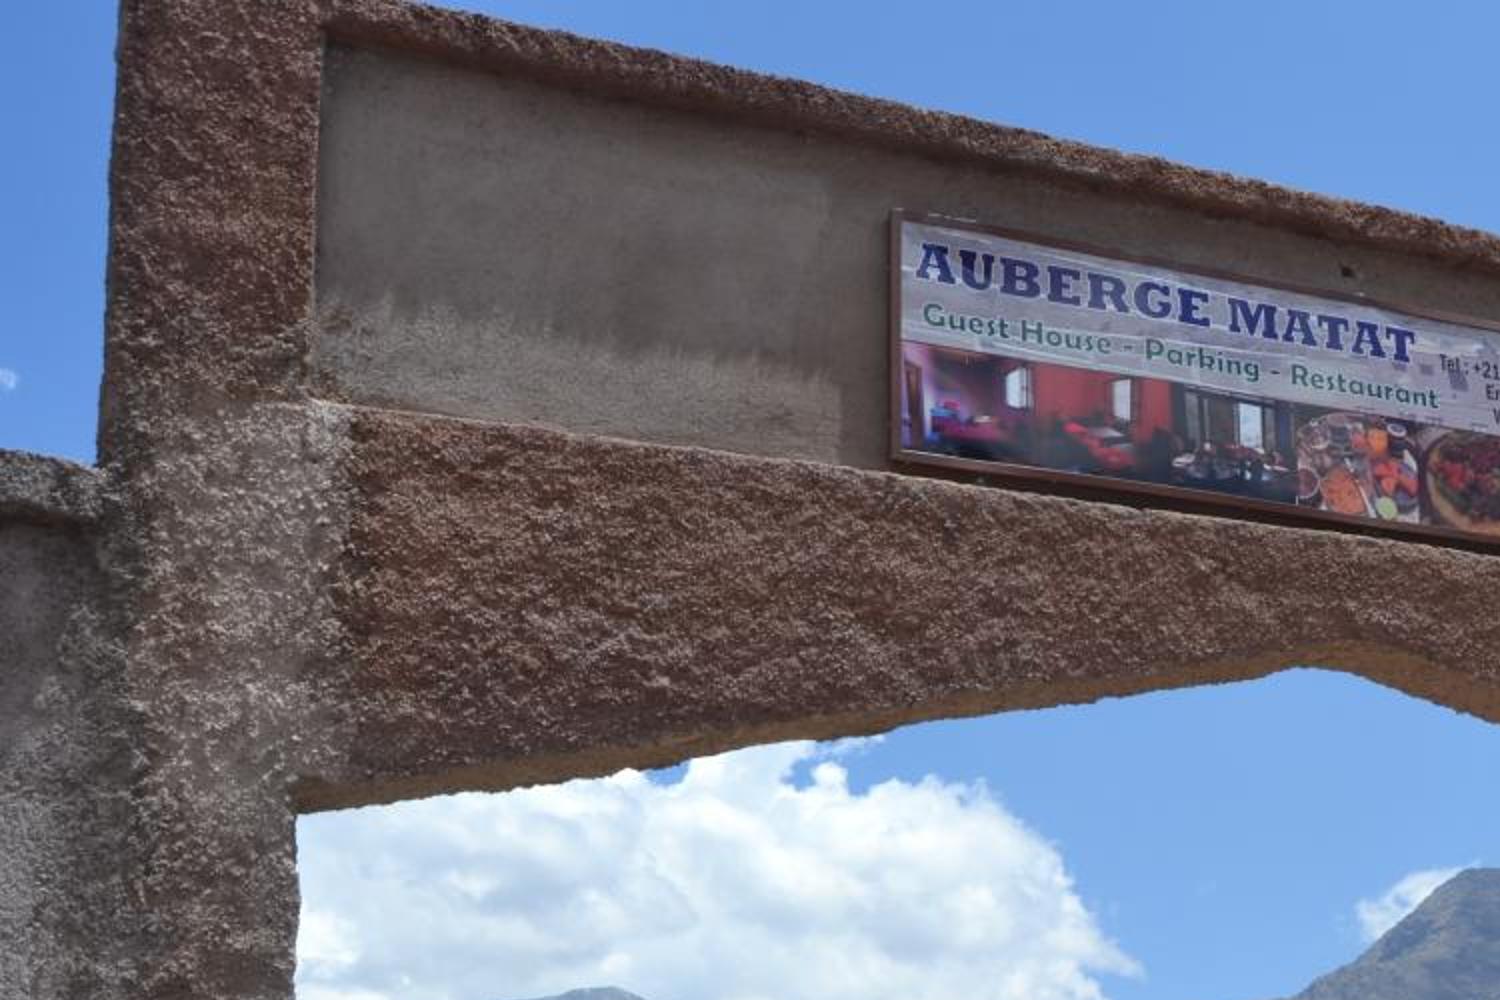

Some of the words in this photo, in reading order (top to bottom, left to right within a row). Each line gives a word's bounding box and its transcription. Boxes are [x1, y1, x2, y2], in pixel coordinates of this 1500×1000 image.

[916, 243, 1210, 327] AUBERGE
[1228, 298, 1415, 362] MATAT
[923, 303, 1008, 339] Guest
[1021, 319, 1111, 354] House
[1145, 339, 1259, 382] Parking
[1291, 364, 1440, 408] Restaurant
